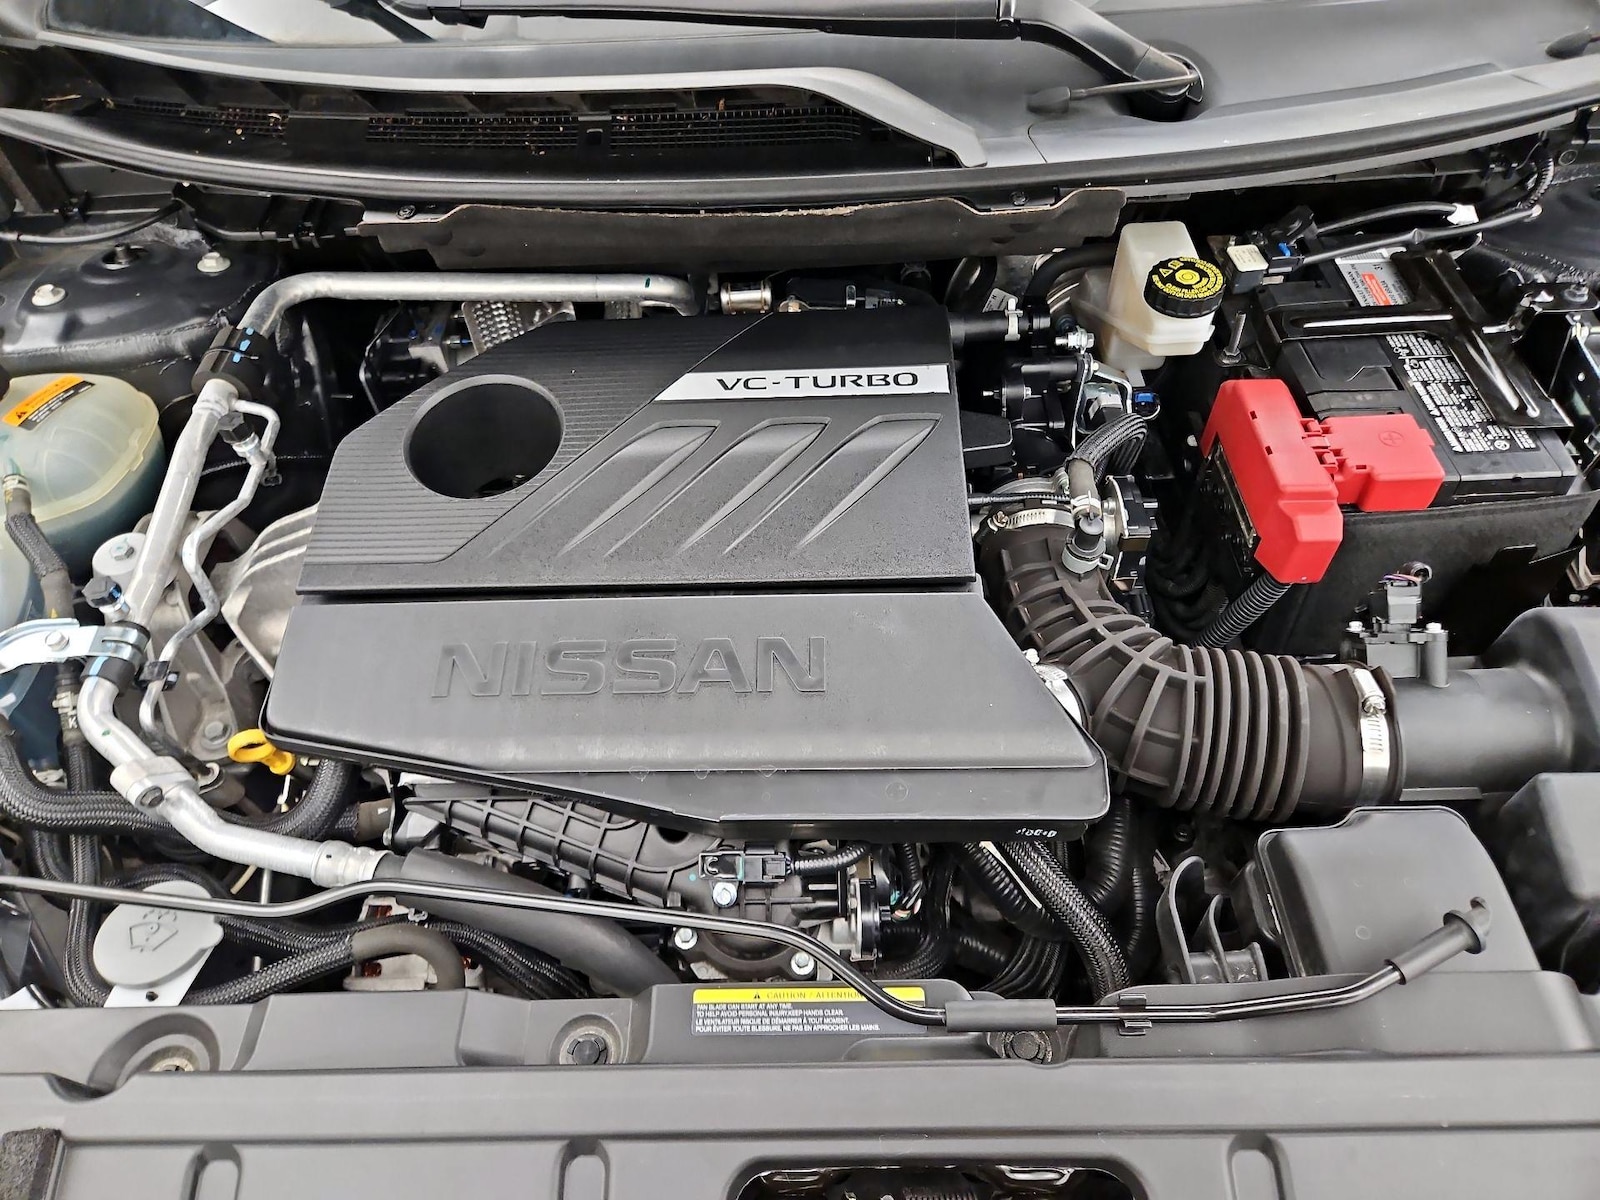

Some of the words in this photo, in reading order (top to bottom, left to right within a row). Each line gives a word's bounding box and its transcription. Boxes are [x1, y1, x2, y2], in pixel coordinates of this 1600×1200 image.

[716, 372, 918, 391] VC-TURBO
[432, 637, 826, 697] NISSAN
[766, 991, 806, 999] CAUTION
